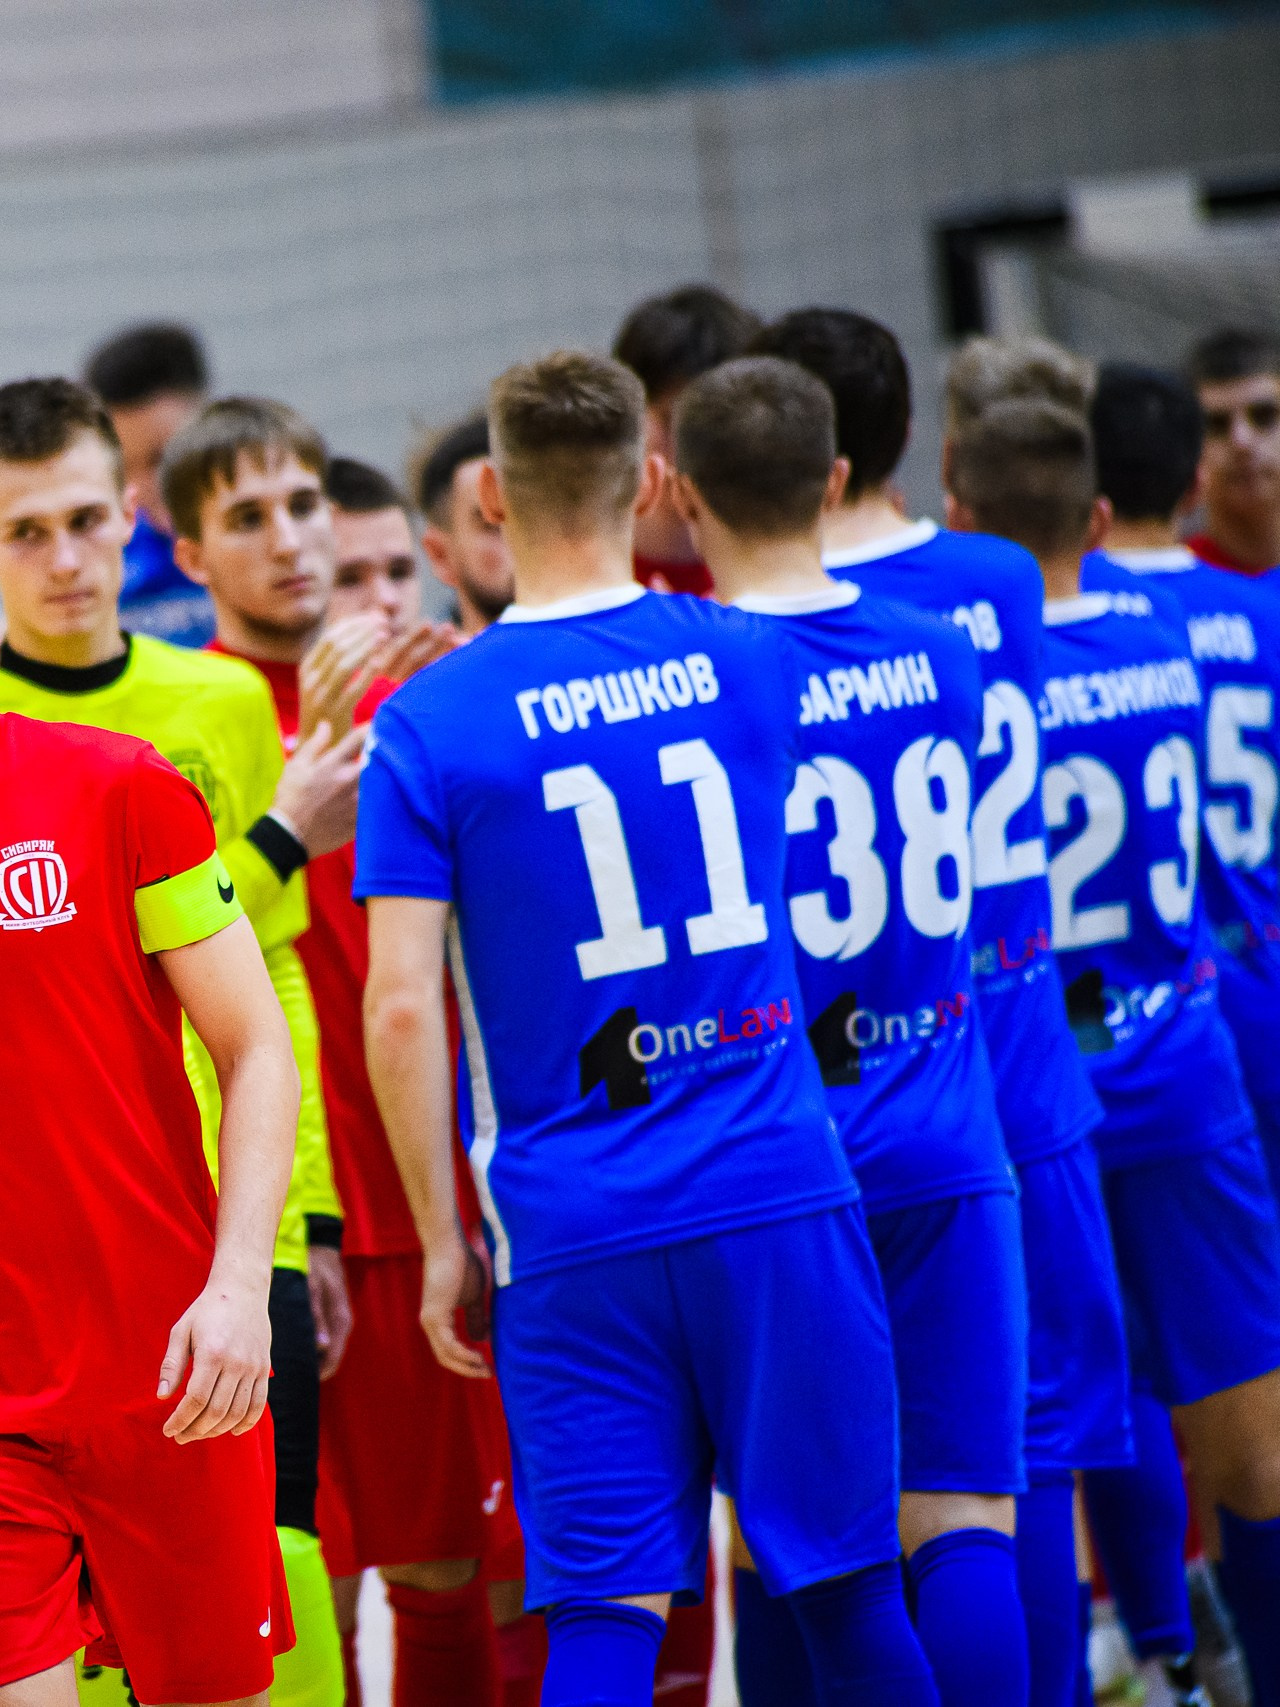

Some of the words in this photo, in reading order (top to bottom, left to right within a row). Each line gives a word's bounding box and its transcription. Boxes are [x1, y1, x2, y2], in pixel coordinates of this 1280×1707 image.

[515, 652, 719, 739] ГОРШКОВ
[799, 651, 938, 725] АРМИН
[0, 839, 55, 860] СИБИРЯК
[542, 738, 768, 981] 11
[785, 735, 972, 962] 38
[1041, 732, 1199, 952] 23
[628, 998, 792, 1063] OneLaw
